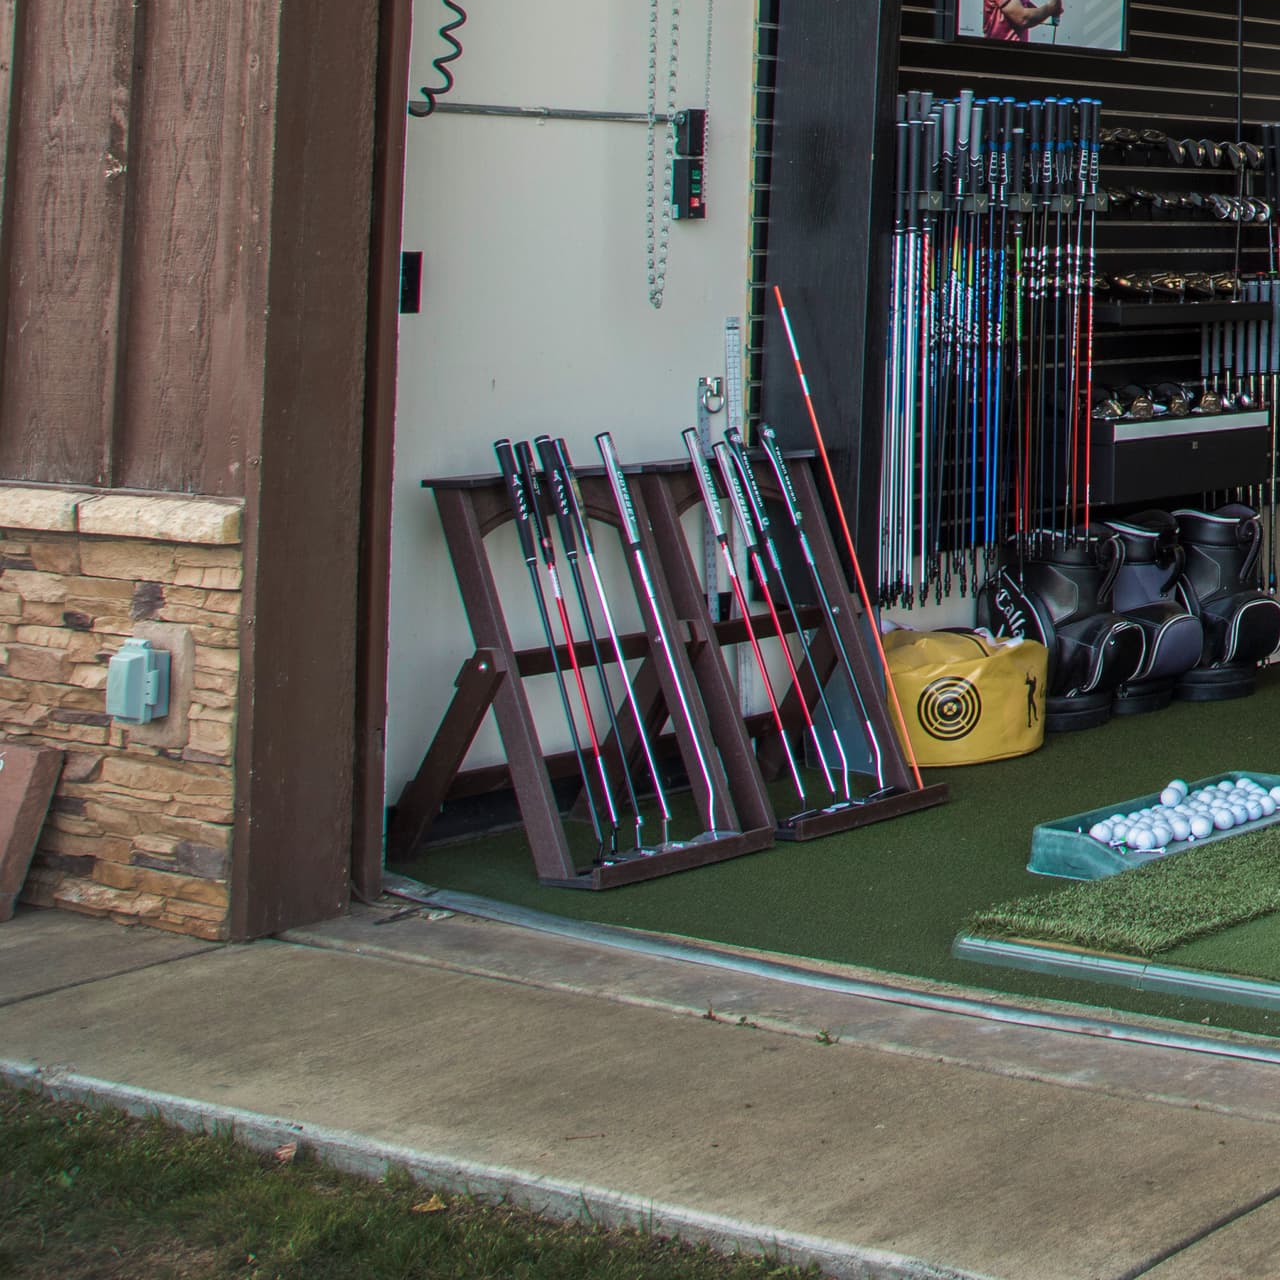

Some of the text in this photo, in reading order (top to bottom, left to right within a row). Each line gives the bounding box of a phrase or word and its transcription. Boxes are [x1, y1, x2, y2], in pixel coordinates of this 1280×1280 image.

[617, 471, 637, 522] ODYSSEY
[702, 464, 722, 516] ODYSSEY
[733, 477, 753, 527] ODYSSEY
[995, 588, 1026, 639] Calla
